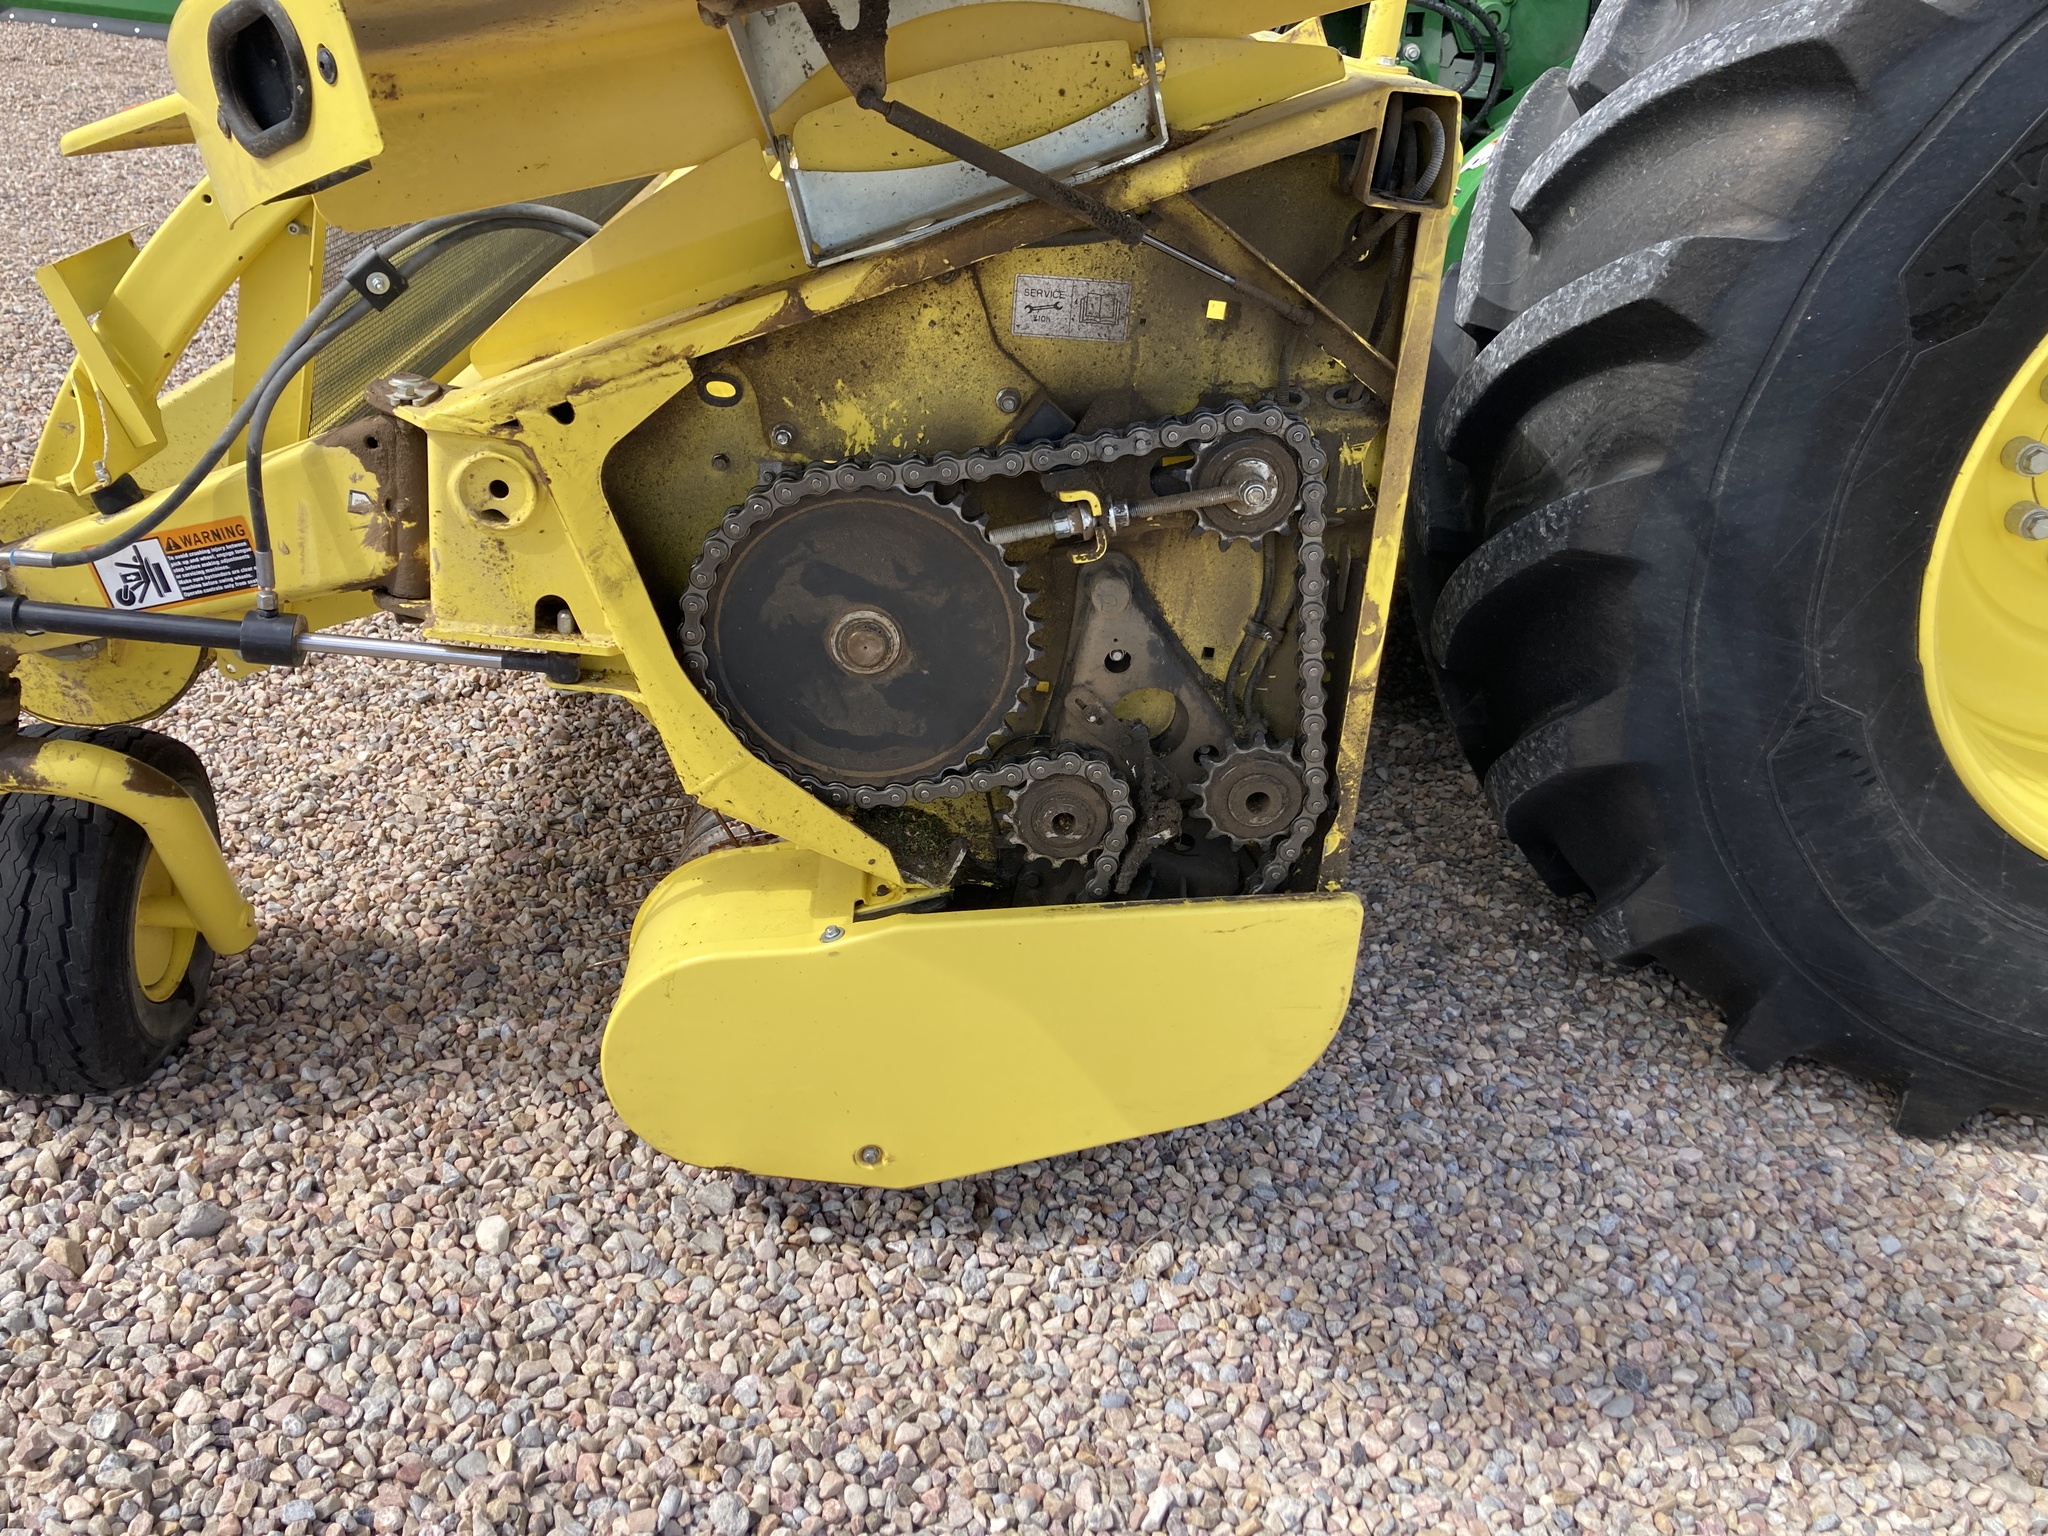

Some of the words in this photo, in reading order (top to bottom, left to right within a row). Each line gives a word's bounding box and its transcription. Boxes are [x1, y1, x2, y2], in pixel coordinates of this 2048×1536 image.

[1024, 288, 1065, 299] SERVICE
[179, 524, 245, 547] WARNING
[189, 549, 211, 557] crushing
[221, 555, 250, 564] adjustments
[183, 569, 205, 577] servicing
[205, 571, 231, 580] bystanders
[181, 583, 201, 591] machine
[184, 589, 203, 597] Operate
[204, 585, 223, 593] controls
